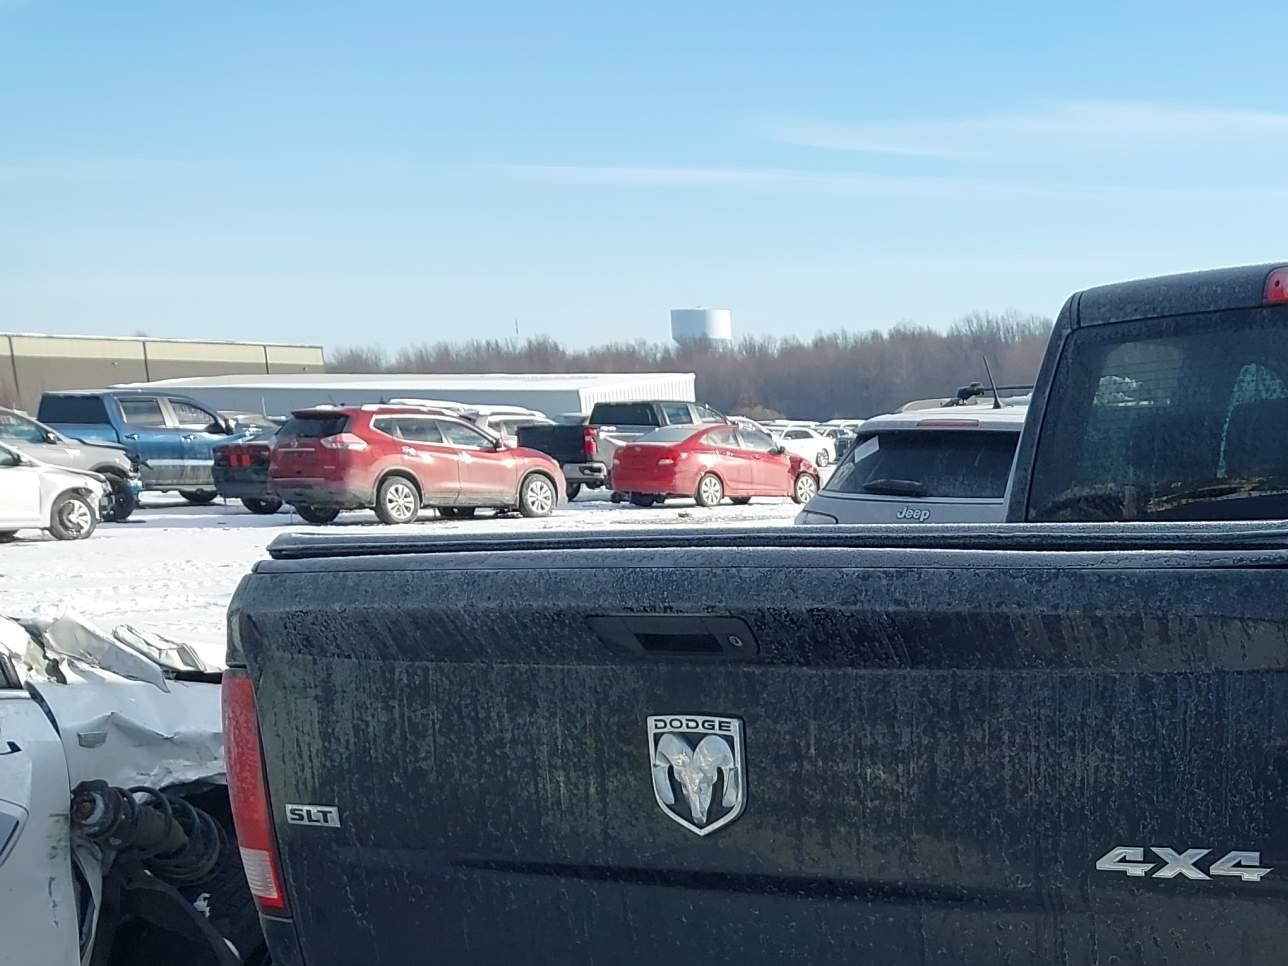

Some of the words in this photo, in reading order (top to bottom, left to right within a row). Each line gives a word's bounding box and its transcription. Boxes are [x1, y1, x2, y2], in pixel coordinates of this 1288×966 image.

[896, 505, 931, 522] Jeep
[653, 718, 732, 733] DODGE
[289, 807, 333, 825] SLT
[1095, 845, 1275, 882] 4X4
